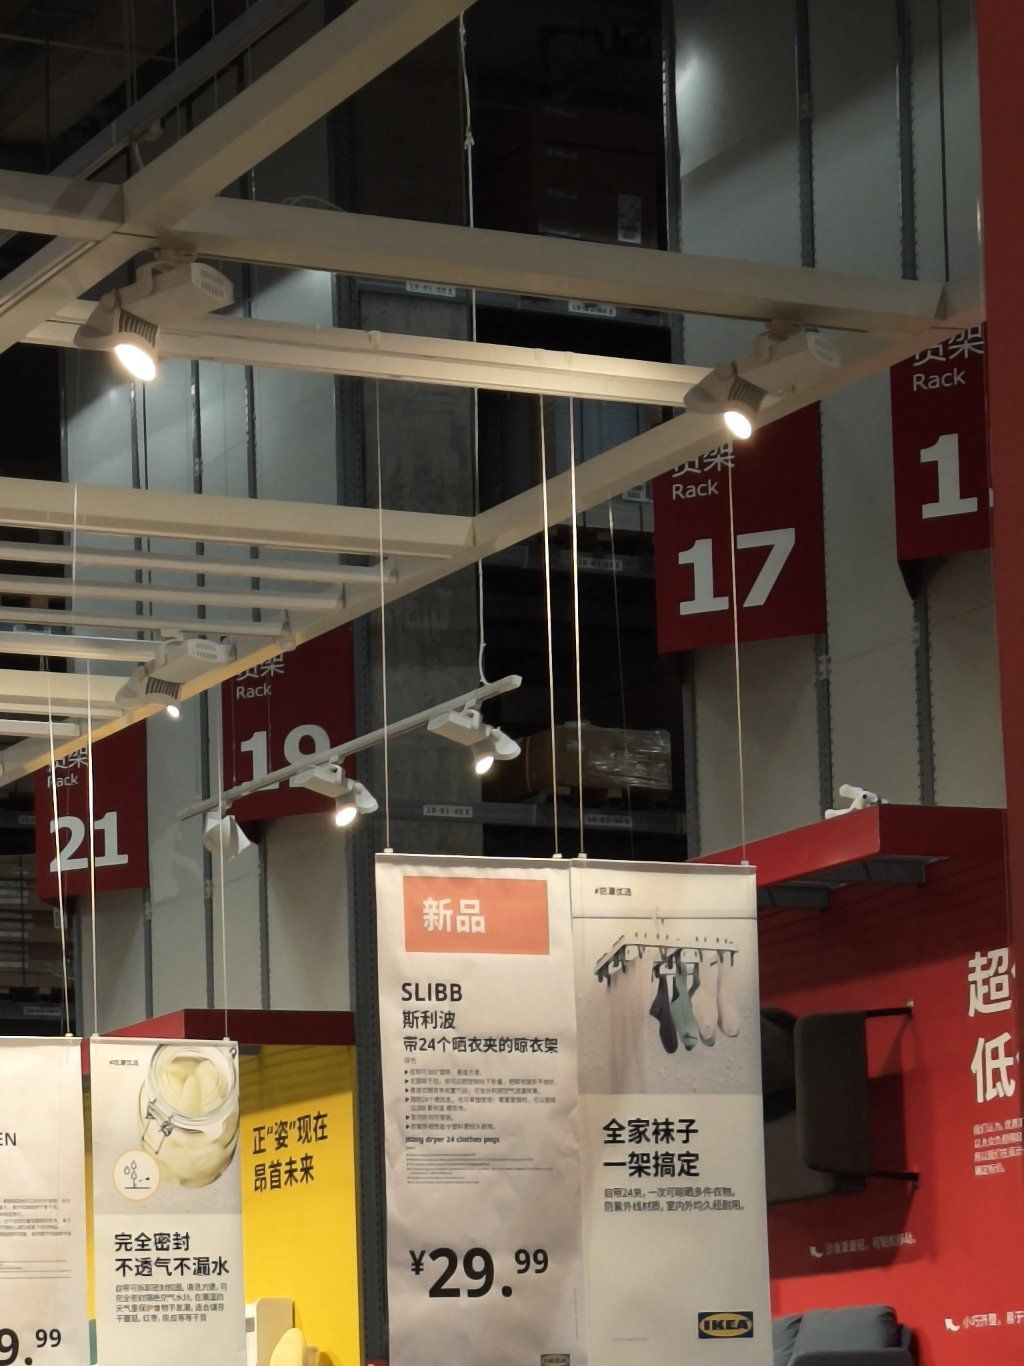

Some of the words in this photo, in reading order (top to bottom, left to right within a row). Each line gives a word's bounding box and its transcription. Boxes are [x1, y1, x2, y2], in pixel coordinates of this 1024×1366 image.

[912, 367, 967, 392] Rack
[919, 433, 994, 520] 1
[672, 479, 719, 501] Rack
[678, 527, 796, 616] 17
[236, 683, 272, 700] Rack
[49, 811, 129, 873] 21
[422, 897, 486, 934] 新品
[401, 982, 463, 1002] SLIBB
[967, 947, 1016, 1018] 超
[402, 1010, 456, 1030] 斯利波
[970, 1032, 1020, 1104] 低
[602, 1118, 699, 1144] 全家袜子
[254, 1152, 315, 1192] 昂首未来
[603, 1151, 700, 1177] 一架搞定
[114, 1232, 190, 1251] 完全密封
[115, 1256, 230, 1277] 不透气不漏水
[409, 1247, 549, 1298] ¥29.99
